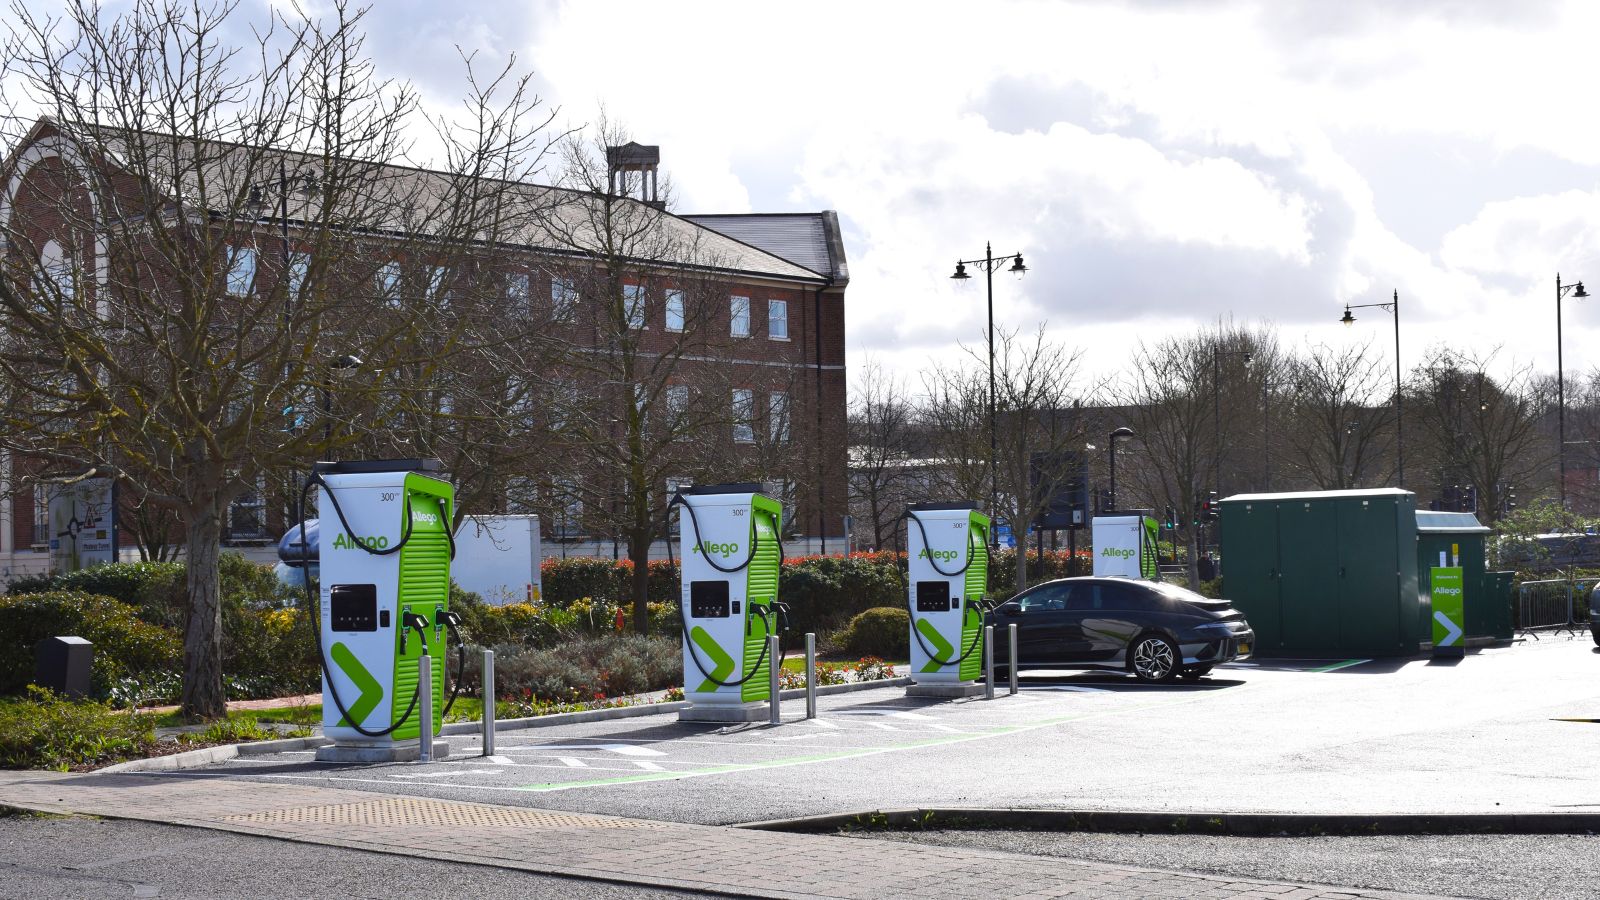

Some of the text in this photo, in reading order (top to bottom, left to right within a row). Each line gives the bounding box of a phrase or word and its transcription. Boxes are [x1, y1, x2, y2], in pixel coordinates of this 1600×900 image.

[381, 492, 395, 501] 300
[412, 511, 437, 525] Allego
[1101, 547, 1135, 560] Allego
[1434, 586, 1461, 596] Allego
